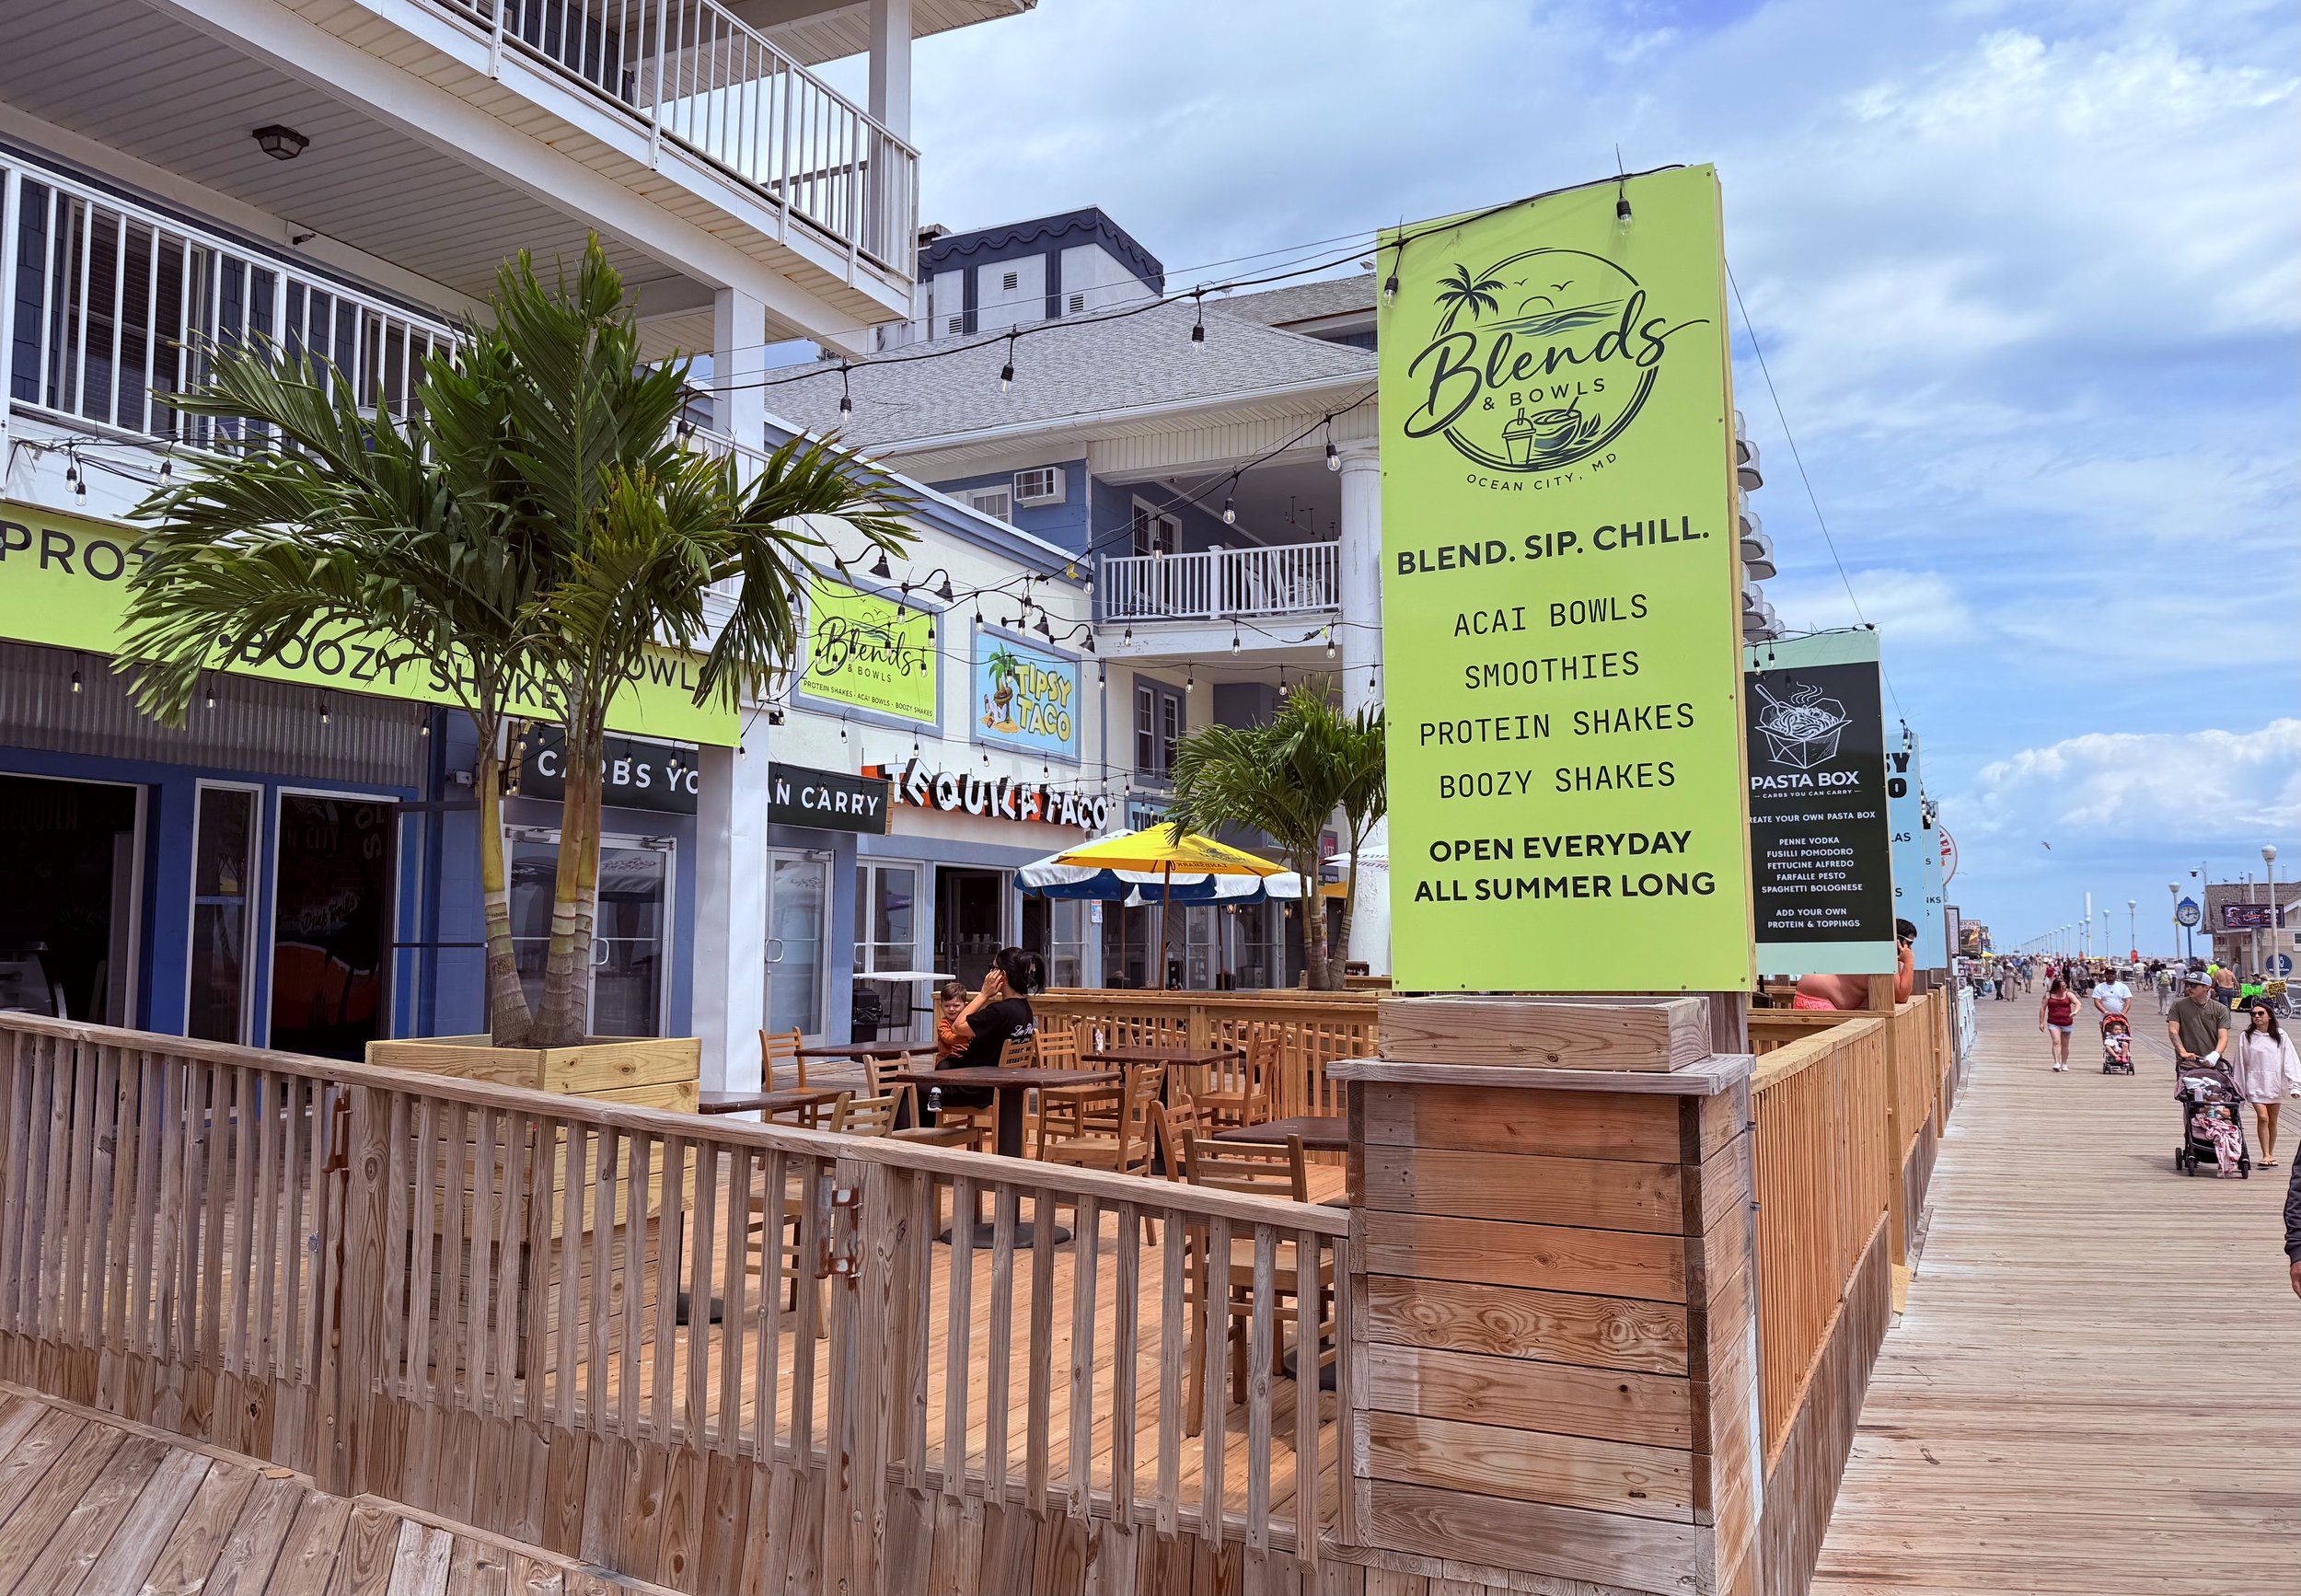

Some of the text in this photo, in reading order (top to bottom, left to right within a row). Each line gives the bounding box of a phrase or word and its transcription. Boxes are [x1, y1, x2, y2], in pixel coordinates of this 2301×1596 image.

[1405, 290, 1710, 439] Blends
[1483, 377, 1606, 411] & BOWLS
[1466, 452, 1617, 492] OCEAN CITY, MD
[1397, 515, 1710, 576] BLEND. SIP. CHILL.
[1453, 594, 1648, 637] ACAI BOWLS
[815, 616, 923, 677] Blends
[858, 666, 893, 684] BOWLS
[1013, 661, 1072, 709] TIPSY
[1464, 651, 1640, 689] SMOOTHIES
[803, 680, 933, 718] PROTEIN SHAKES ACAI BOWLS BOOZY SHAKES
[1017, 694, 1071, 742] TACO
[1420, 702, 1695, 746] PROTEIN SHAKES
[885, 758, 1108, 830] TEQUILA TACO
[1440, 761, 1676, 799] BOOZY SHAKES
[1751, 770, 1860, 791] PASTA BOX
[1763, 791, 1788, 799] CARBS
[801, 787, 880, 817] CARRY
[1749, 811, 1876, 824] REATE YOUR OWN PASTA BOX
[1429, 830, 1693, 862] OPEN EVERYDAY
[1766, 848, 1854, 858] FUSILLI POMODORO
[1778, 836, 1840, 846] PENNE VODKA
[1767, 860, 1855, 871] FETTUCINE ALFREDO
[1776, 872, 1846, 882] FARFALLE PESTO
[1415, 872, 1716, 903] ALL SUMMER LONG
[1762, 884, 1863, 894] SPAGHETTI BOLOGNESE
[1767, 919, 1861, 929] PROTEIN & TOPPINGS
[1775, 908, 1847, 917] ADD YOUR OWN
